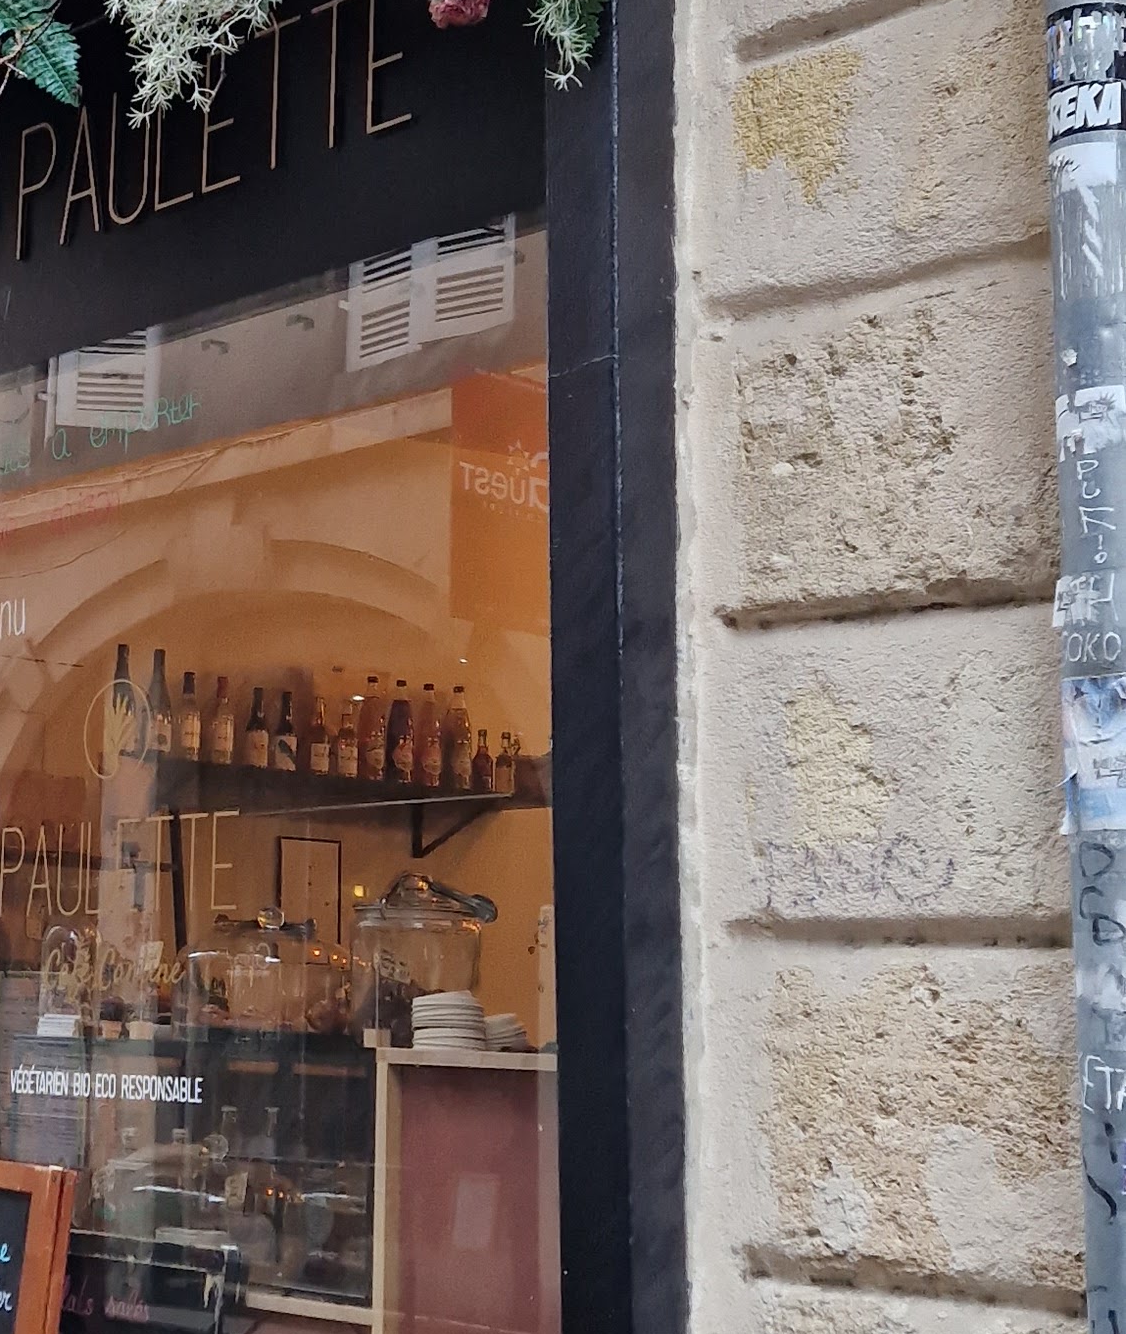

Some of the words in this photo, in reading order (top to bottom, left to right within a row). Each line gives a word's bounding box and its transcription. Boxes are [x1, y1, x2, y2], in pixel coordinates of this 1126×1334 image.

[73, 1072, 91, 1098] BIO
[95, 1073, 116, 1099] ECO
[121, 1074, 204, 1104] RESPONSABLE
